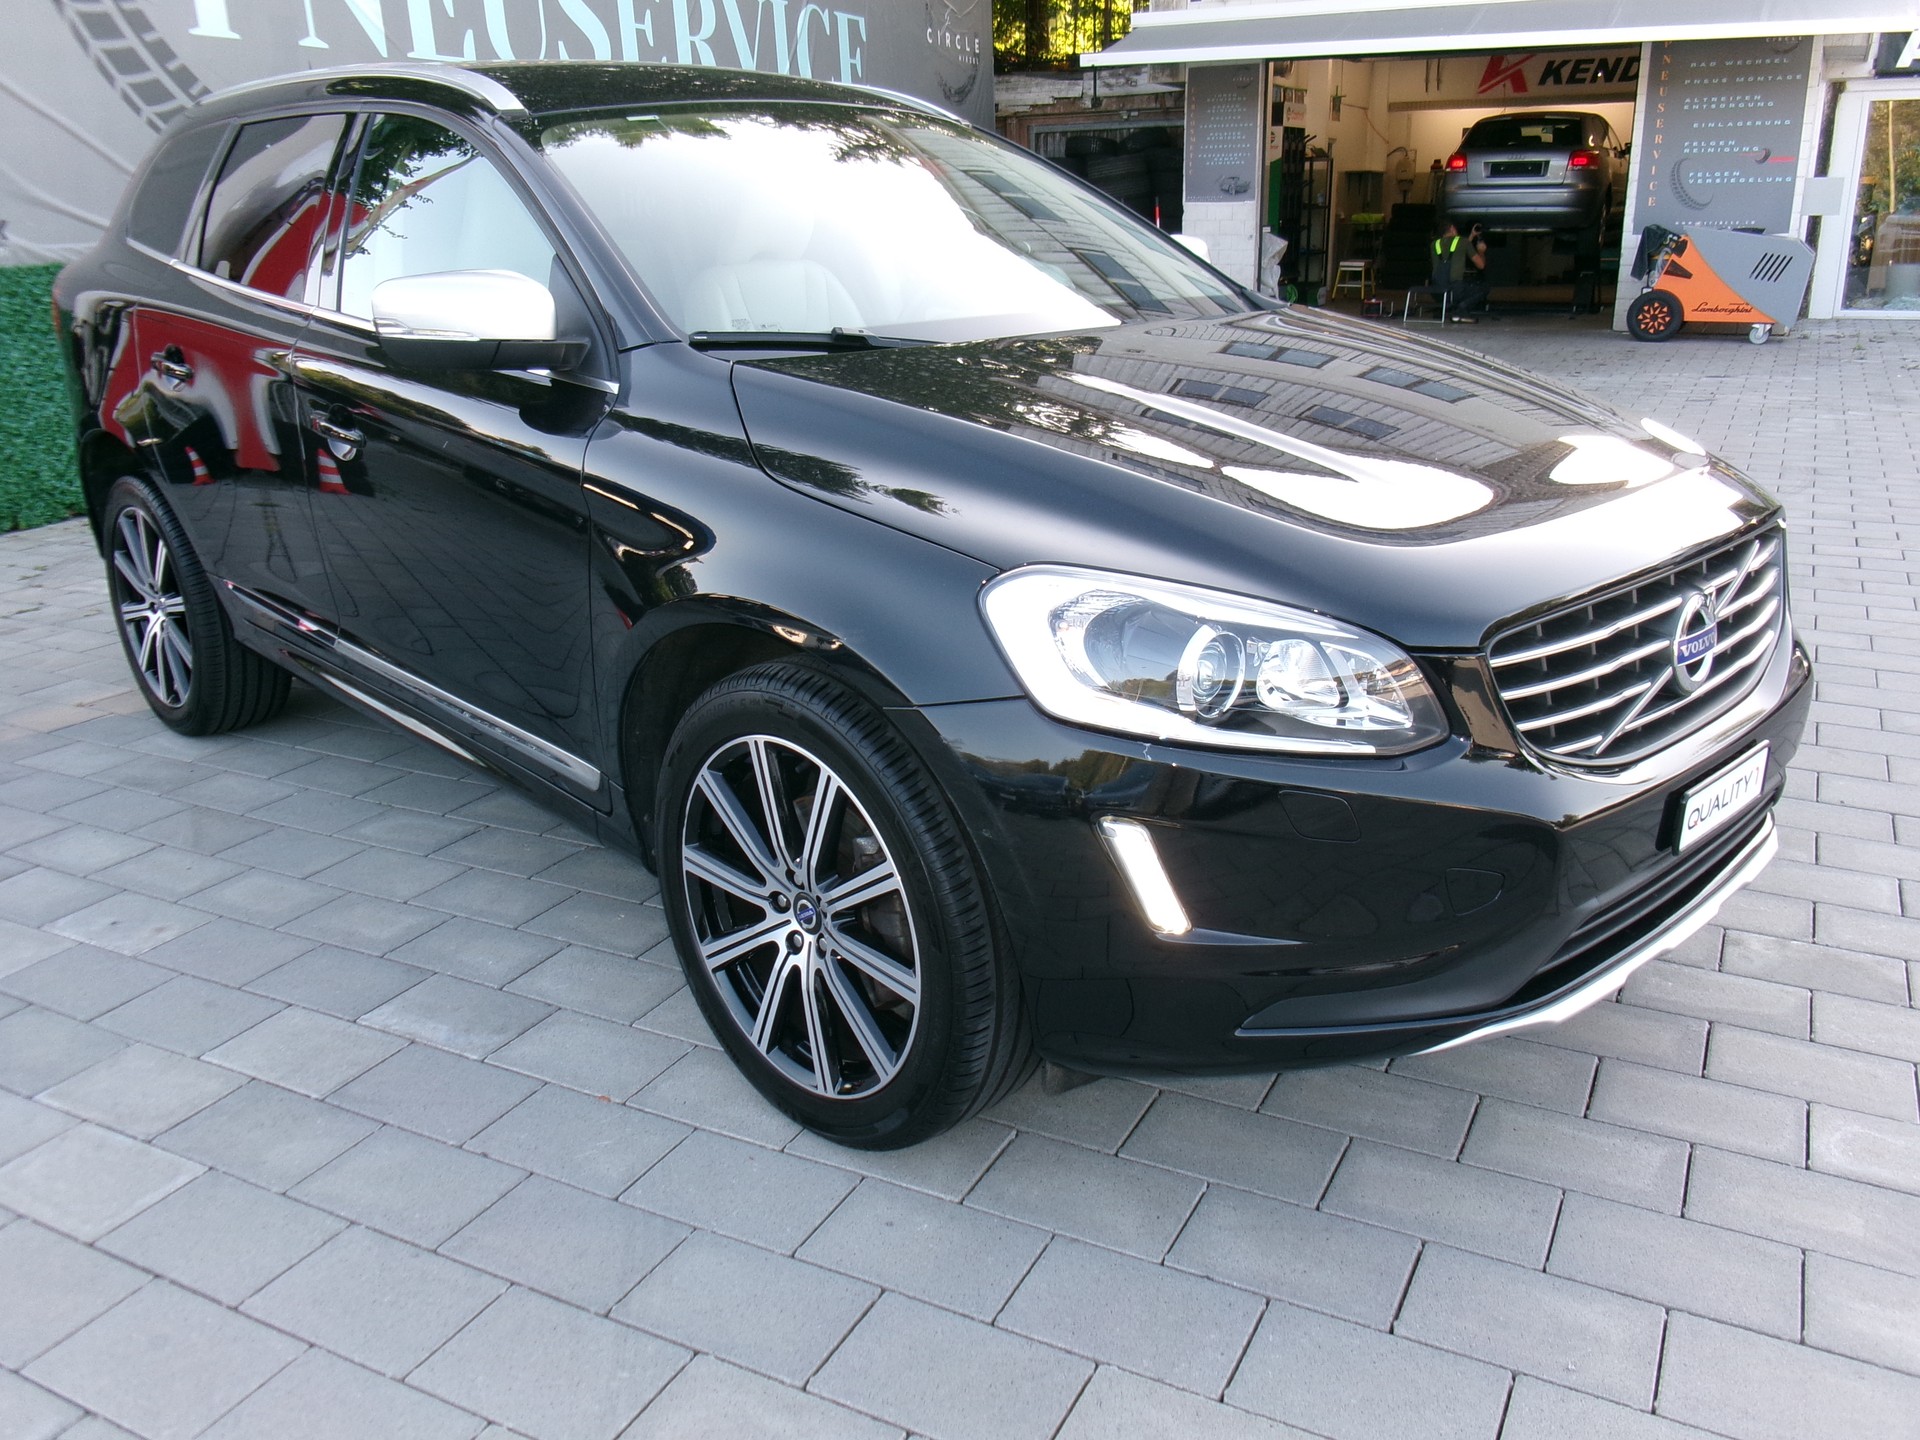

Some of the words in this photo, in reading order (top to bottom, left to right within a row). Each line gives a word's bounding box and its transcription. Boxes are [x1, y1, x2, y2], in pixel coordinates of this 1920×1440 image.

[926, 27, 980, 54] CIRCLE
[1725, 57, 1790, 66] WECHSEL
[1693, 119, 1791, 128] EINLAGERUNG
[1688, 176, 1792, 184] VERSIEGELUNG
[1691, 301, 1754, 316] Lamborghini
